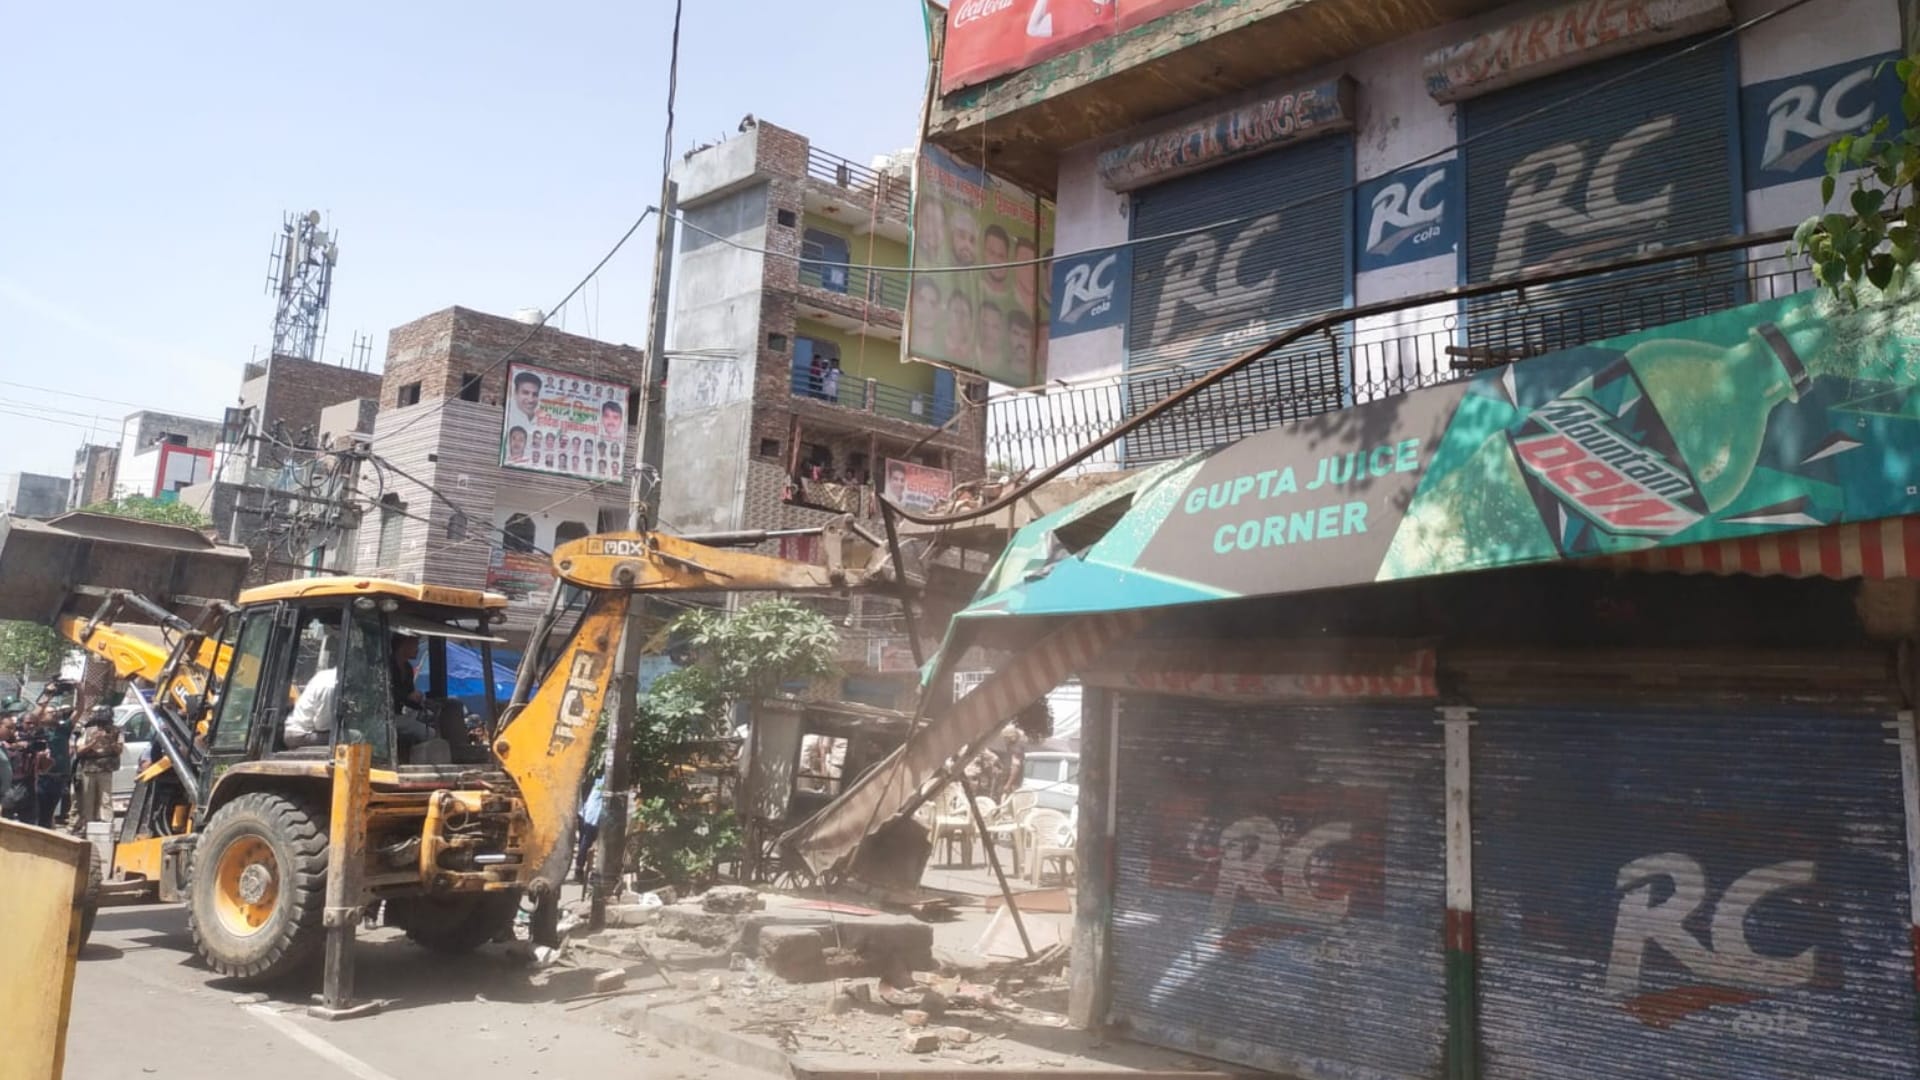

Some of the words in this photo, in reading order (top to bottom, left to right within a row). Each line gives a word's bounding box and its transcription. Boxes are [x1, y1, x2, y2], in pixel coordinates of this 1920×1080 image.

[1760, 66, 1875, 170] RC
[1366, 167, 1445, 252] RC
[1413, 226, 1441, 243] cola
[1489, 114, 1676, 280] RC
[1058, 253, 1117, 322] RC
[1151, 214, 1281, 346] RC
[1184, 466, 1297, 514] GUPTA
[1305, 438, 1421, 490] JUICE
[1542, 404, 1692, 496] Mountain
[1213, 500, 1368, 554] CORNER
[1207, 815, 1353, 931] RC
[1604, 852, 1818, 998] RC
